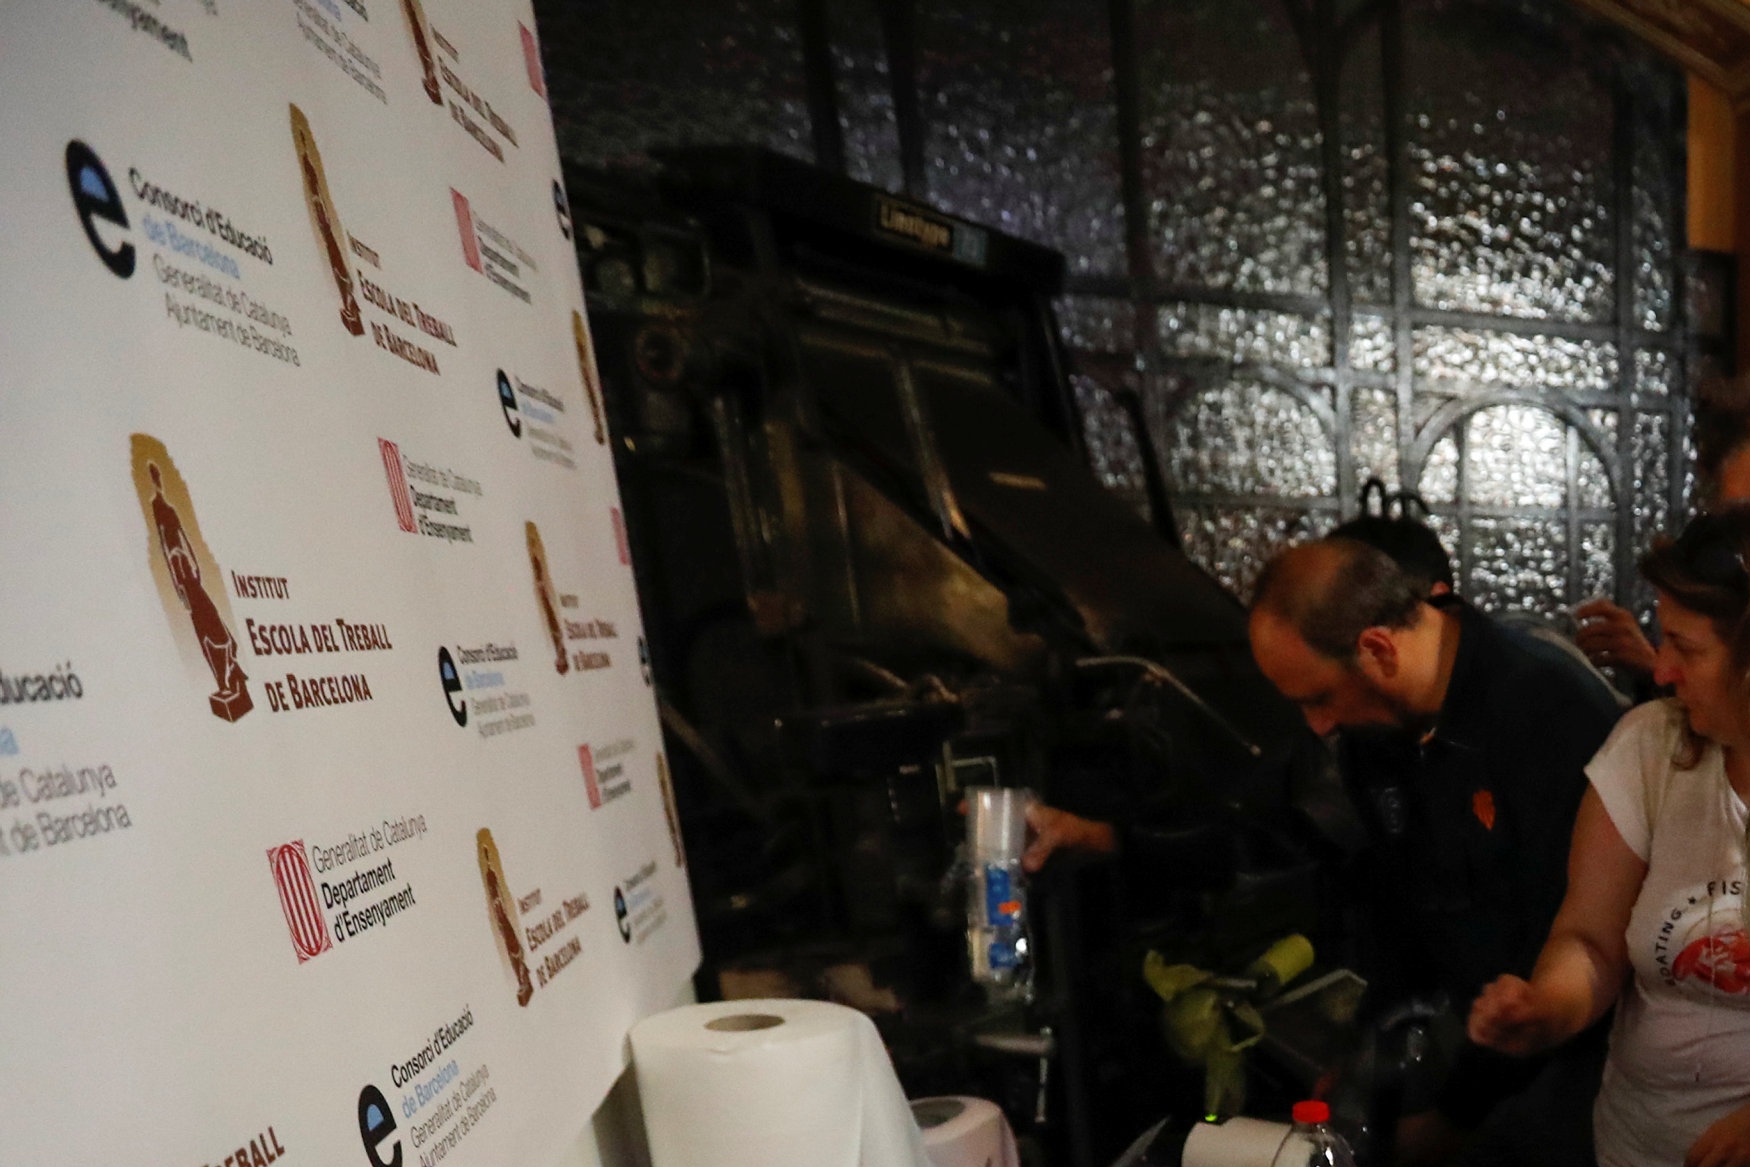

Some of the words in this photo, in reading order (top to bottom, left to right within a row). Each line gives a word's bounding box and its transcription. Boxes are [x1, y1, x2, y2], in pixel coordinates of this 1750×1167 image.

[128, 167, 204, 229] Consorci
[205, 206, 273, 265] d'Educació
[153, 253, 224, 306] Generalitat
[231, 569, 289, 600] INSTITUT
[245, 618, 313, 656] ESCOLA
[311, 624, 340, 652] DEL
[335, 618, 393, 652] TREBALL
[264, 681, 290, 713] DE
[285, 673, 373, 710] BARCELONA
[19, 764, 118, 803] Catalunya
[10, 821, 40, 853] de
[36, 803, 133, 846] Barcelona
[311, 832, 369, 873] Generalitat
[370, 827, 384, 852] de
[382, 814, 428, 848] Catalunya
[320, 858, 396, 910] Departament
[334, 883, 417, 943] d'Ensenyament
[391, 1036, 435, 1089] Consorci
[433, 1003, 475, 1056] d'Educació
[401, 1093, 416, 1119] de
[414, 1059, 460, 1108] Barcelona
[410, 1100, 452, 1150] Generalitat
